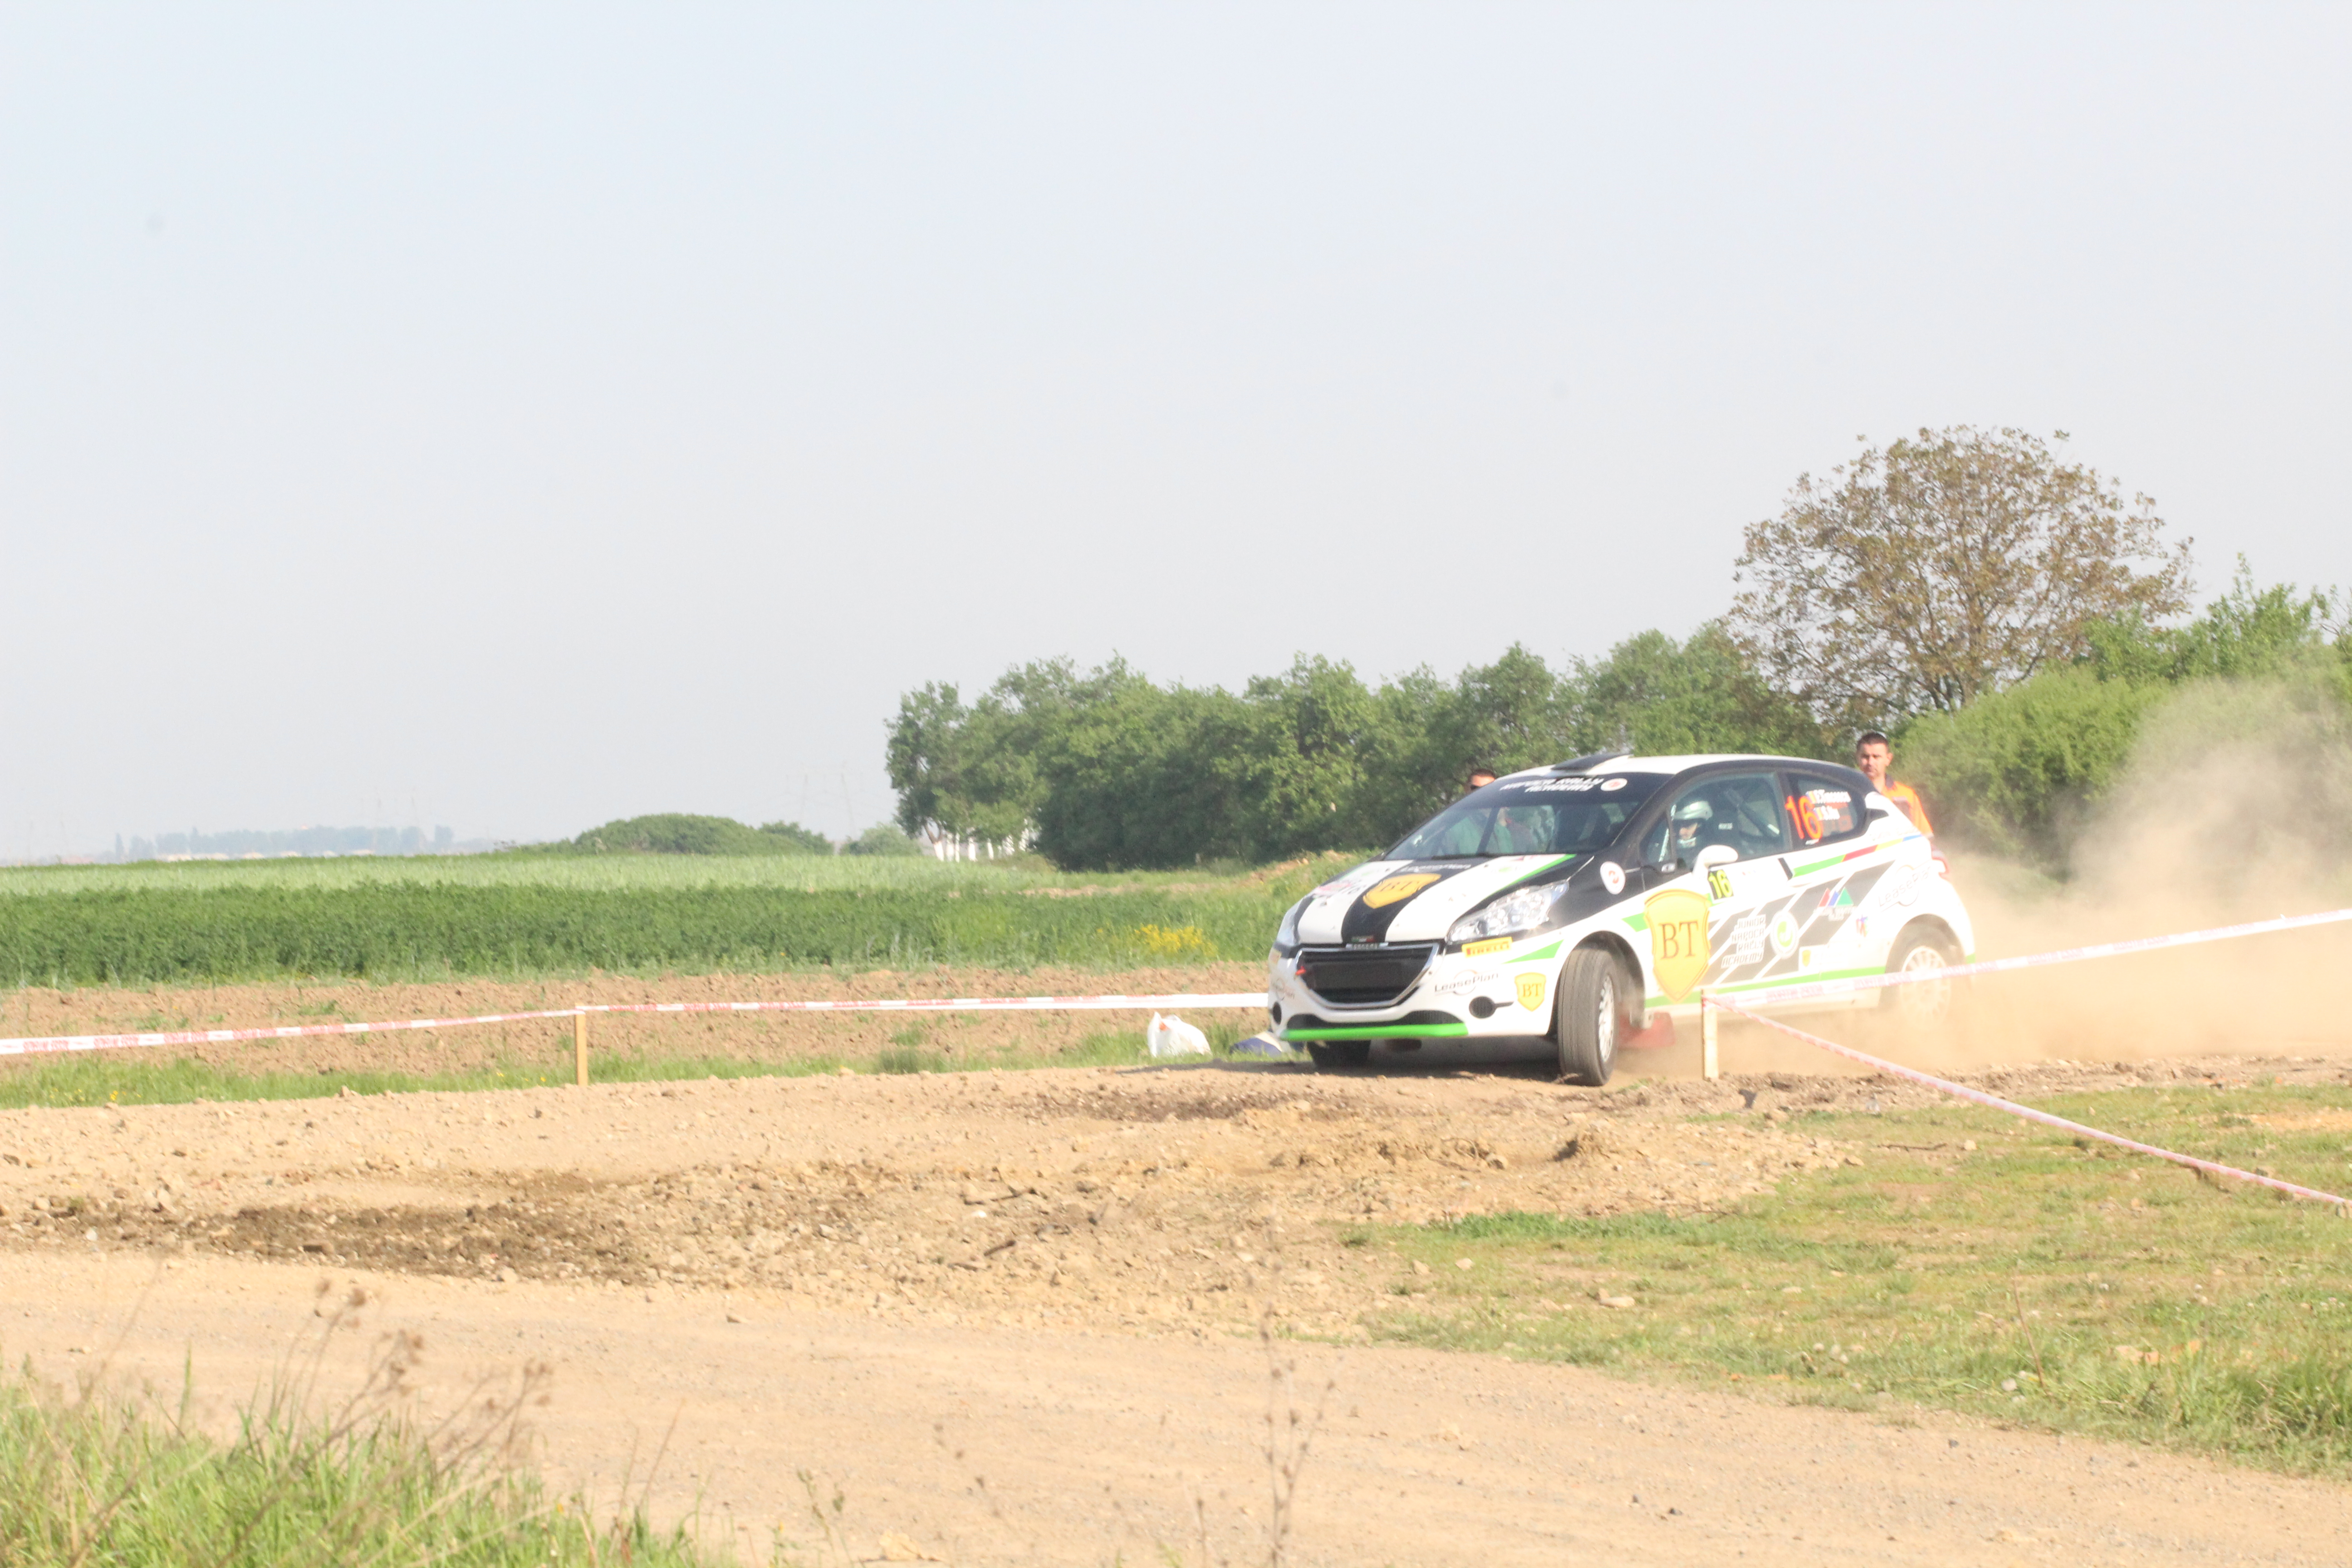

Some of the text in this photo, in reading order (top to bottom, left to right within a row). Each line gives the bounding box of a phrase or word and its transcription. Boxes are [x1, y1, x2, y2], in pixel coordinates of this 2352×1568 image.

[1784, 795, 1824, 840] 16
[1708, 870, 1733, 899] 16
[1735, 917, 1765, 929] JUNIOR
[1659, 920, 1699, 960] BT
[1731, 928, 1764, 942] NAPOCA
[1466, 941, 1509, 956] PIRELLI
[1722, 951, 1763, 966] ACADEMY
[1434, 973, 1499, 992] LeasePlan
[1522, 983, 1542, 998] BT
